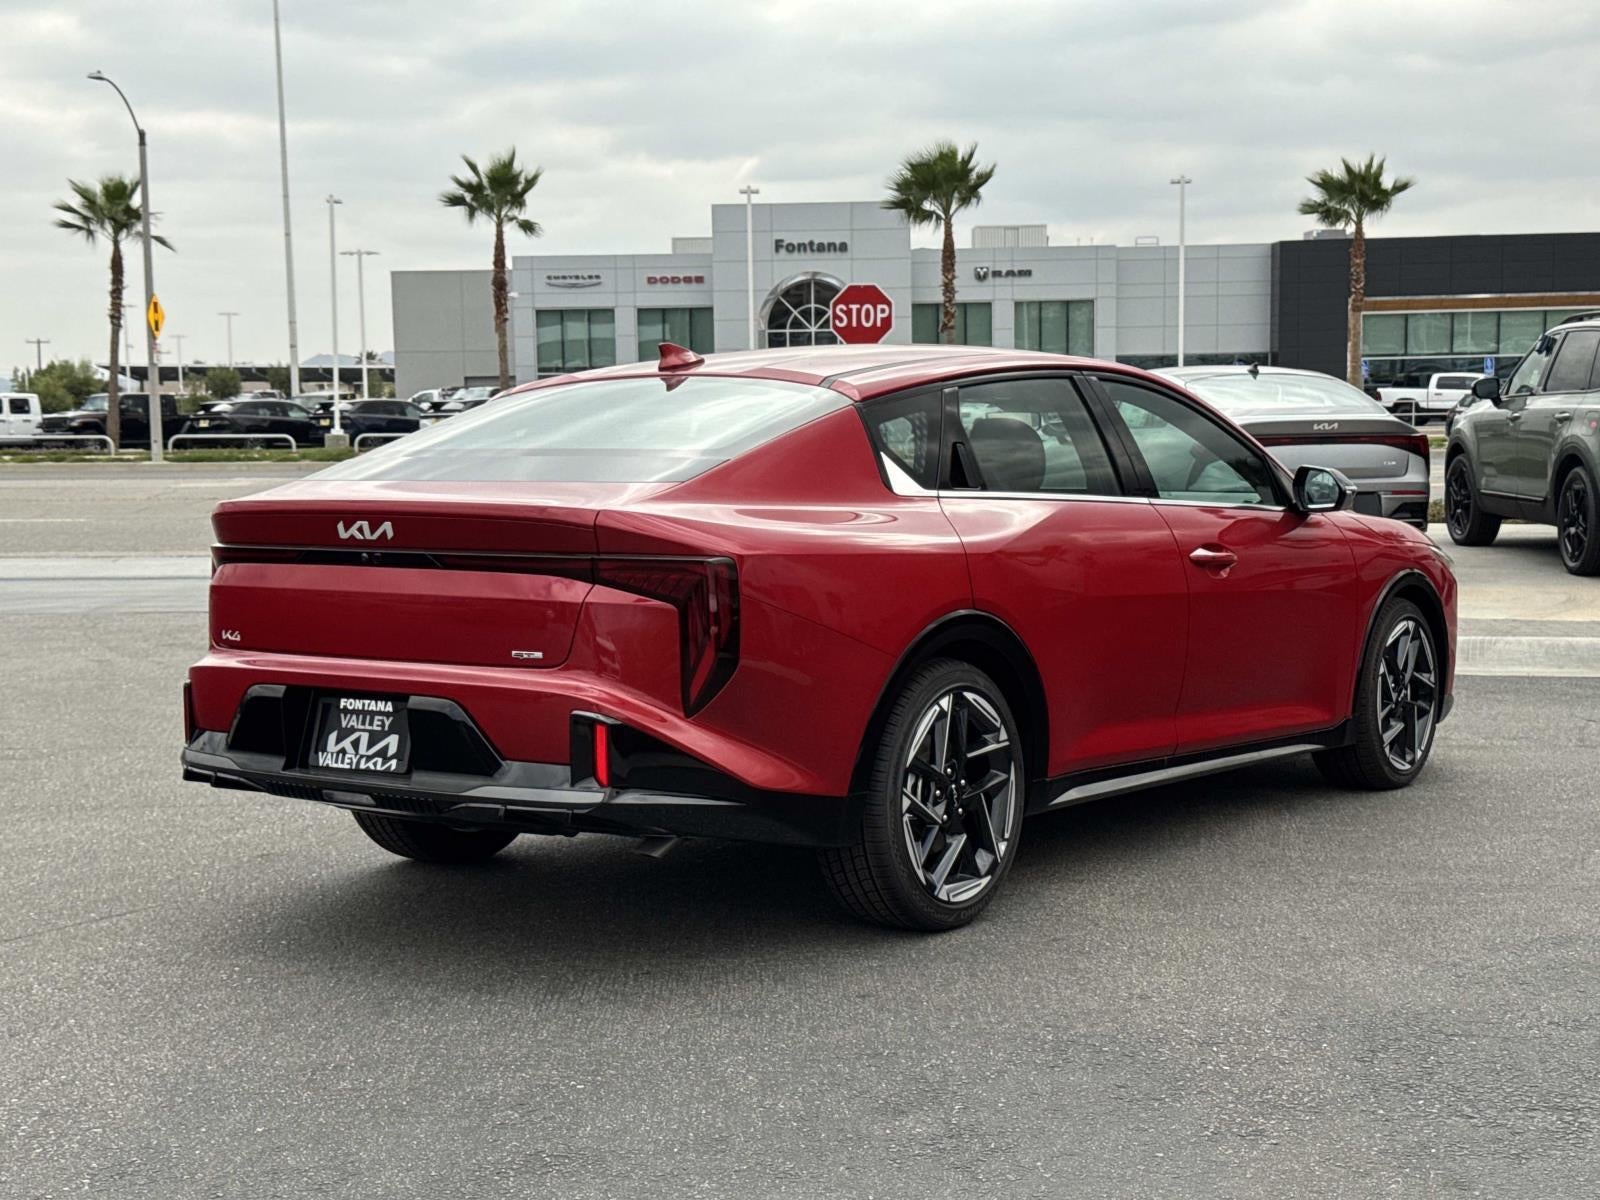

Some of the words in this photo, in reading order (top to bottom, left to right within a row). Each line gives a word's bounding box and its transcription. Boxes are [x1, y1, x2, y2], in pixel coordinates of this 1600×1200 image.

[774, 239, 848, 254] Fontana
[646, 275, 705, 285] DODGE
[991, 269, 1033, 278] RAM
[835, 304, 890, 328] STOP
[1313, 422, 1338, 431] KIA
[337, 520, 394, 540] KIA
[221, 629, 241, 641] K4
[340, 698, 393, 712] FONTANA
[340, 713, 393, 731] VALLEY
[326, 730, 399, 757] KIA
[318, 751, 360, 769] VALLEY
[359, 756, 398, 771] KIA
